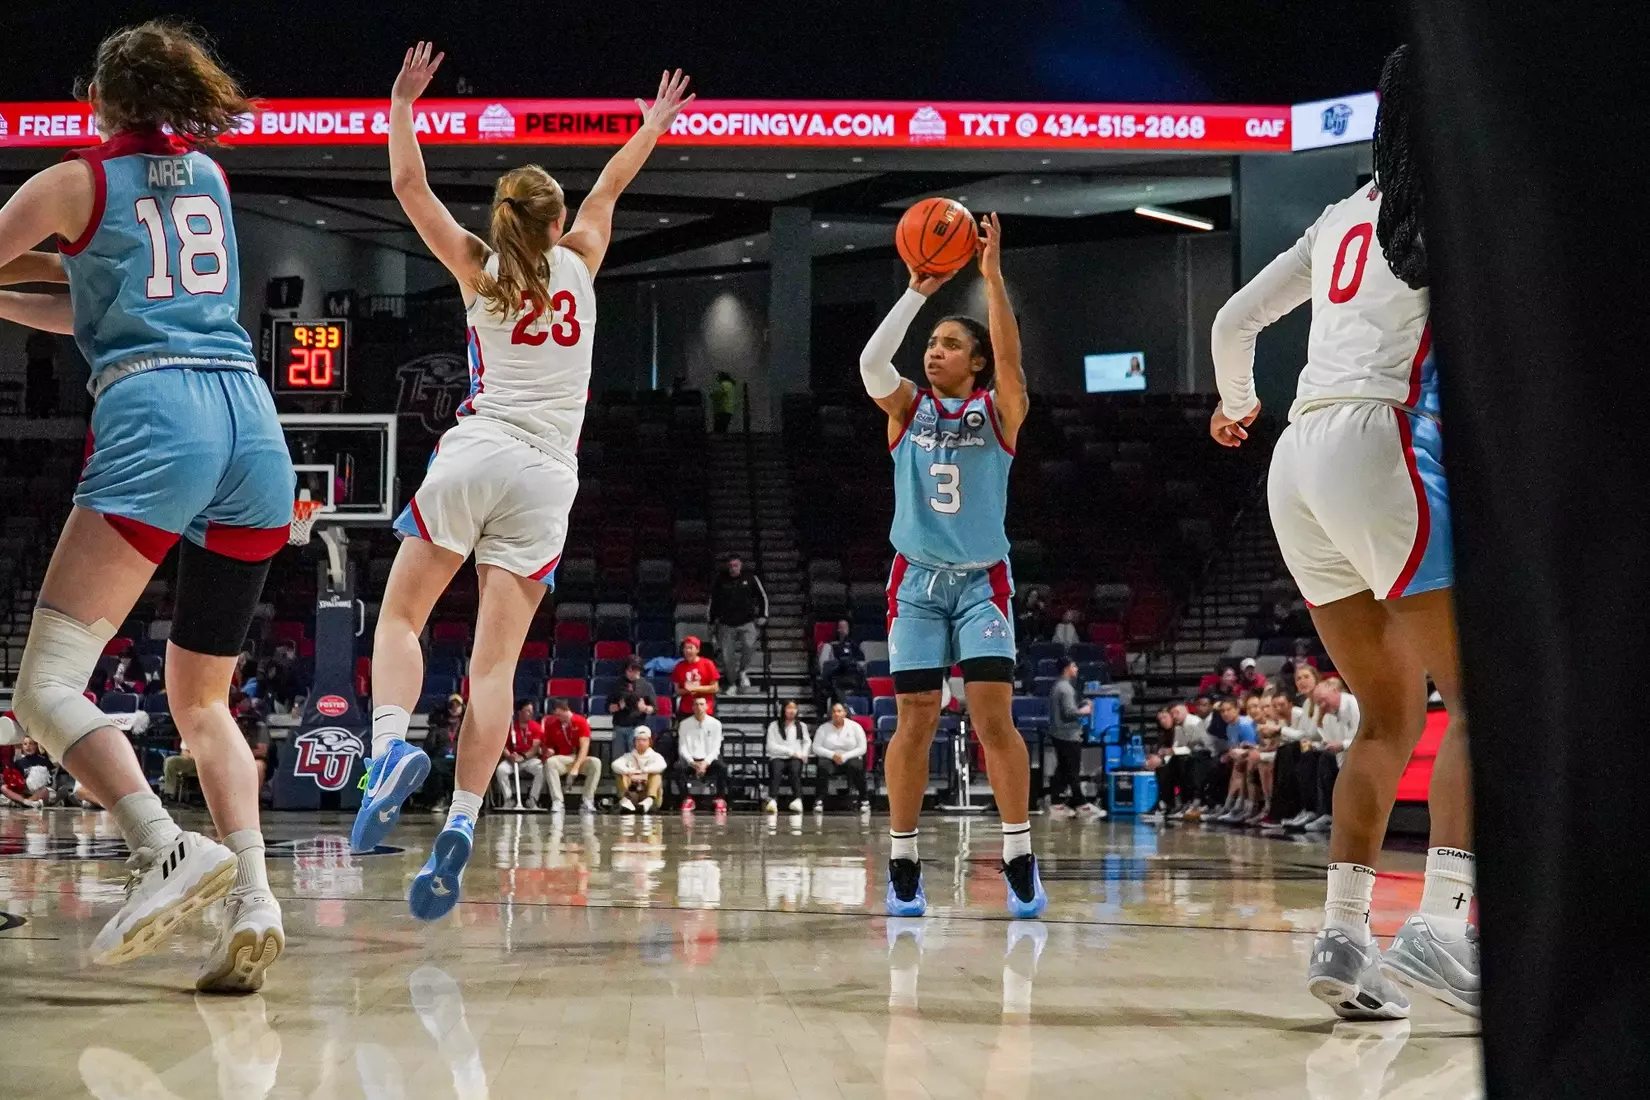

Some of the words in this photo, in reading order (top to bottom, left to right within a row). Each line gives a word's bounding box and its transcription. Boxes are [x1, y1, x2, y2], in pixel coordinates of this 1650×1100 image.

[19, 115, 82, 136] FREE
[261, 113, 365, 135] BUNDLE
[413, 112, 467, 134] AVE
[960, 114, 1010, 136] TXT
[1015, 113, 1038, 137] @
[1043, 114, 1205, 138] 434-515-2868
[1245, 119, 1285, 138] GAF
[148, 159, 194, 187] AIREY
[135, 195, 228, 298] 18
[1328, 221, 1373, 304] 0
[511, 290, 581, 347] 23
[293, 326, 339, 348] 9:33
[288, 348, 333, 386] 20
[928, 463, 962, 515] 3
